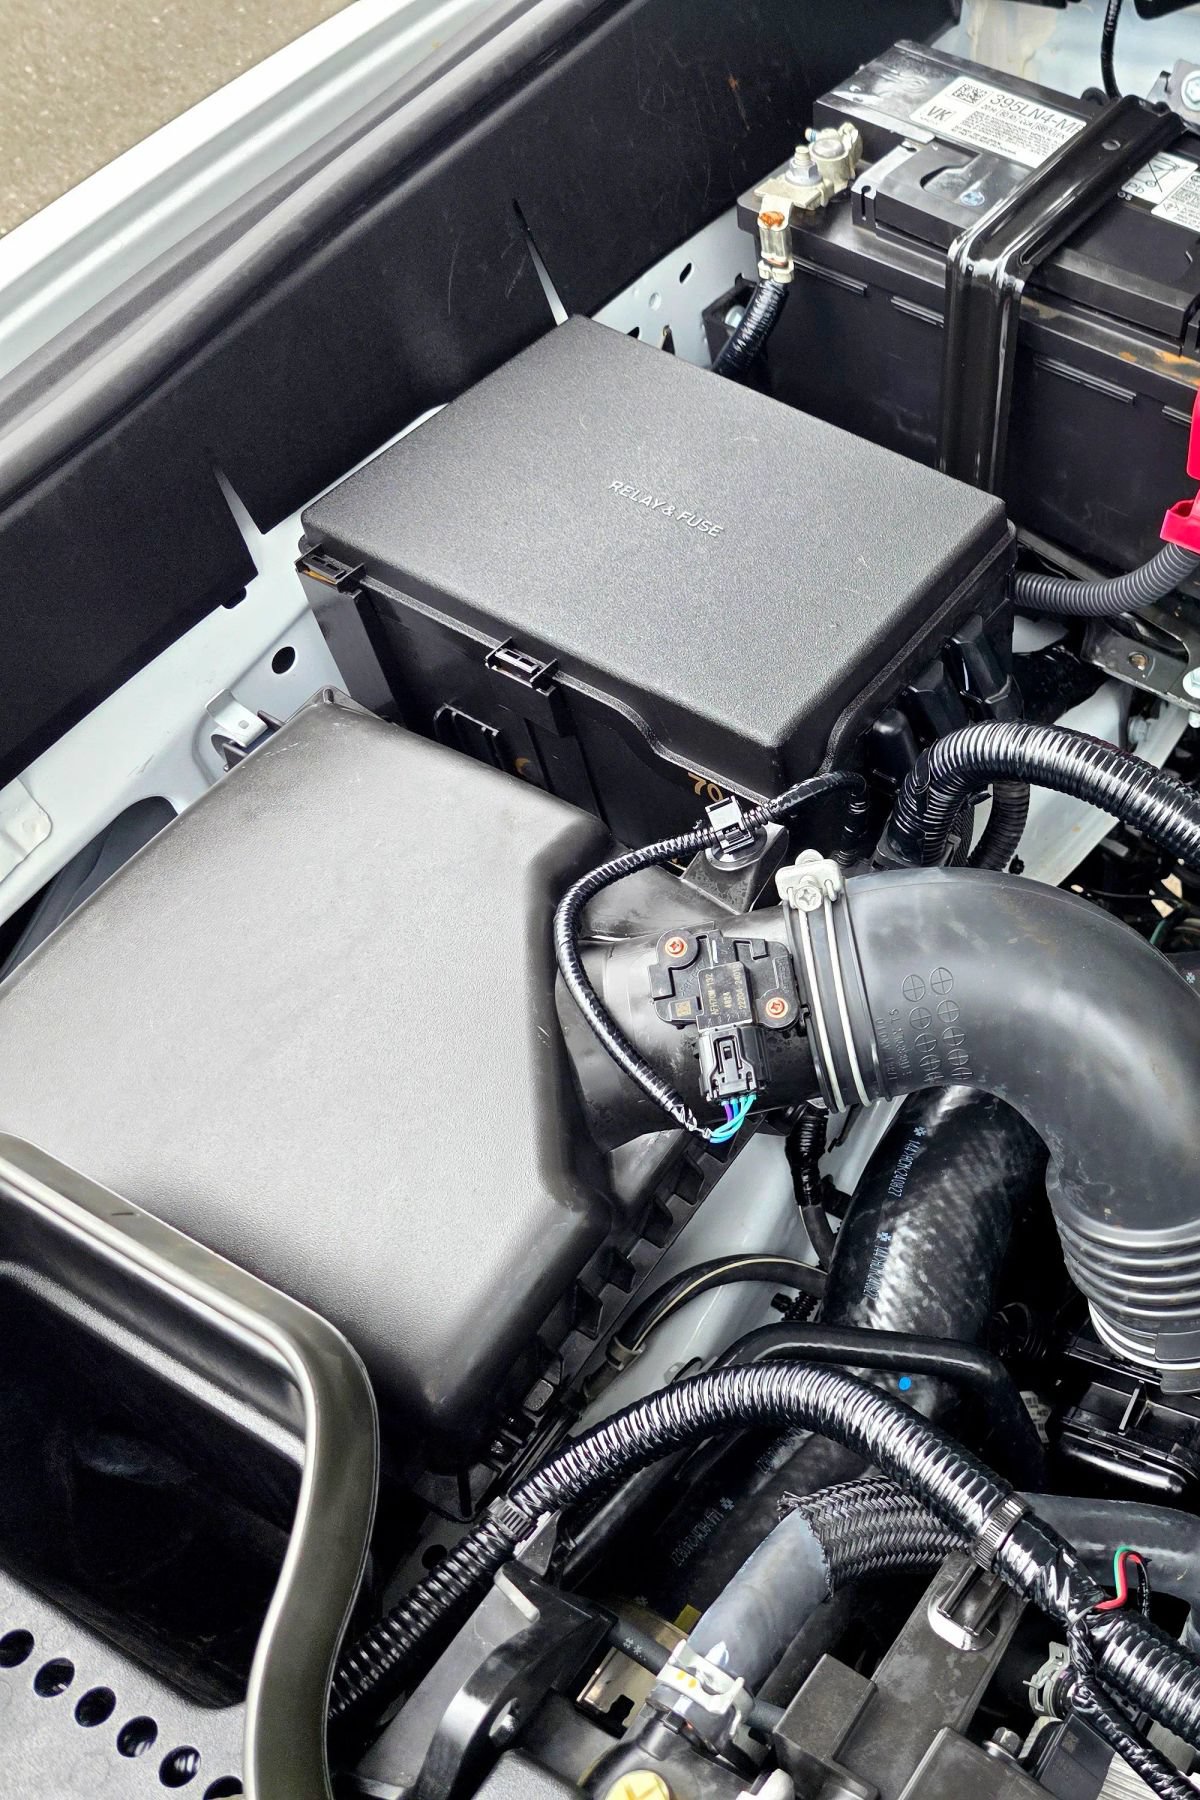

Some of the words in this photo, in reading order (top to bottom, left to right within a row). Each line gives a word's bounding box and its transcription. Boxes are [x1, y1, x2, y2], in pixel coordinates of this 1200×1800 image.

[608, 480, 666, 510] RELAY
[662, 505, 676, 517] &
[676, 511, 724, 538] FUSE
